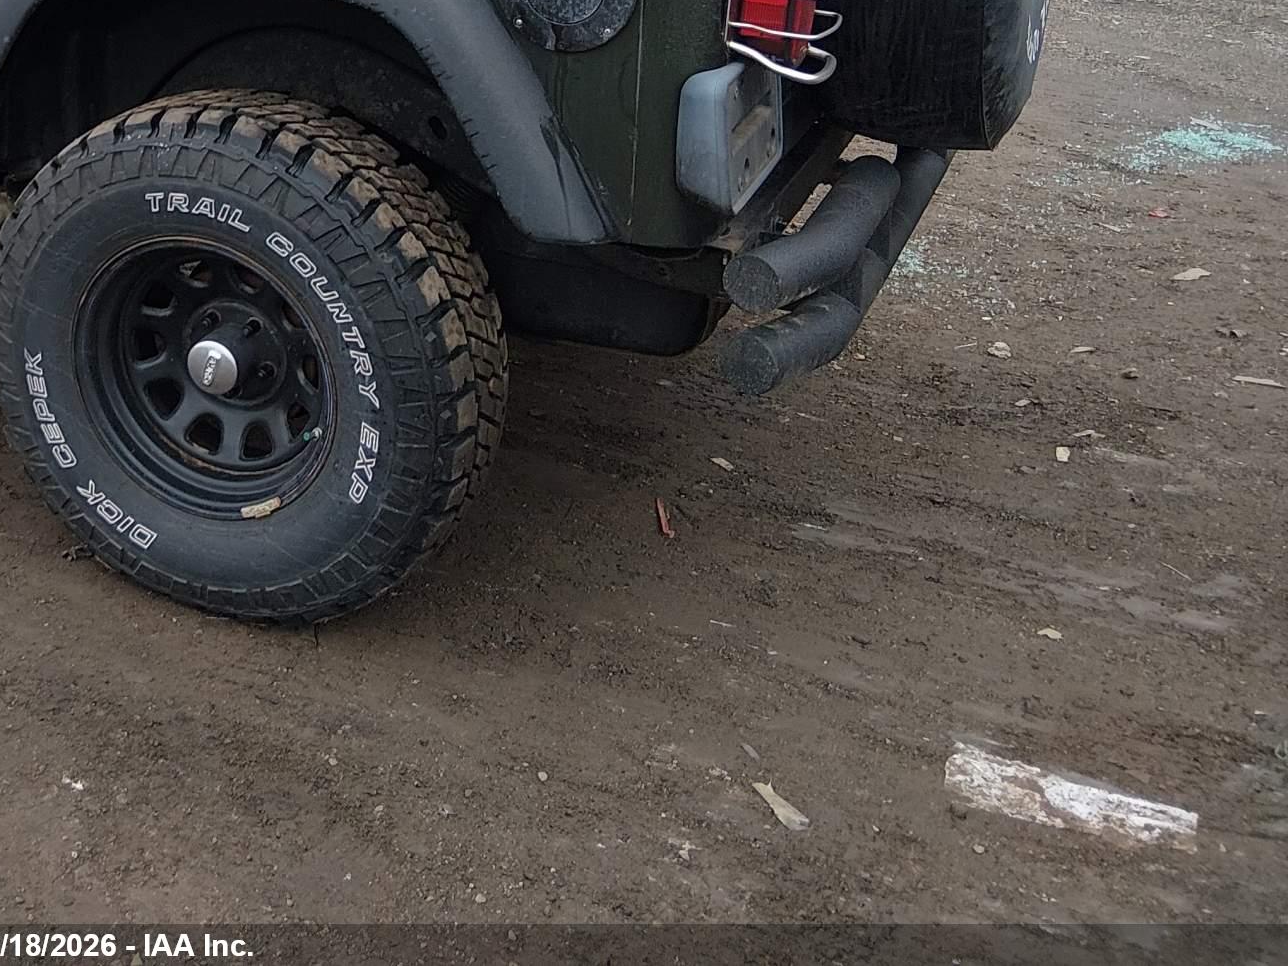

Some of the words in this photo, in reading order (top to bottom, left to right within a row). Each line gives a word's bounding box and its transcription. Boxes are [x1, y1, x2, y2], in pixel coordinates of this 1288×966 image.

[145, 191, 250, 233] TRAIL
[266, 232, 380, 409] COUNTRY
[348, 423, 380, 504] EXP
[23, 348, 77, 468] CEPEK
[76, 480, 157, 550] DICK
